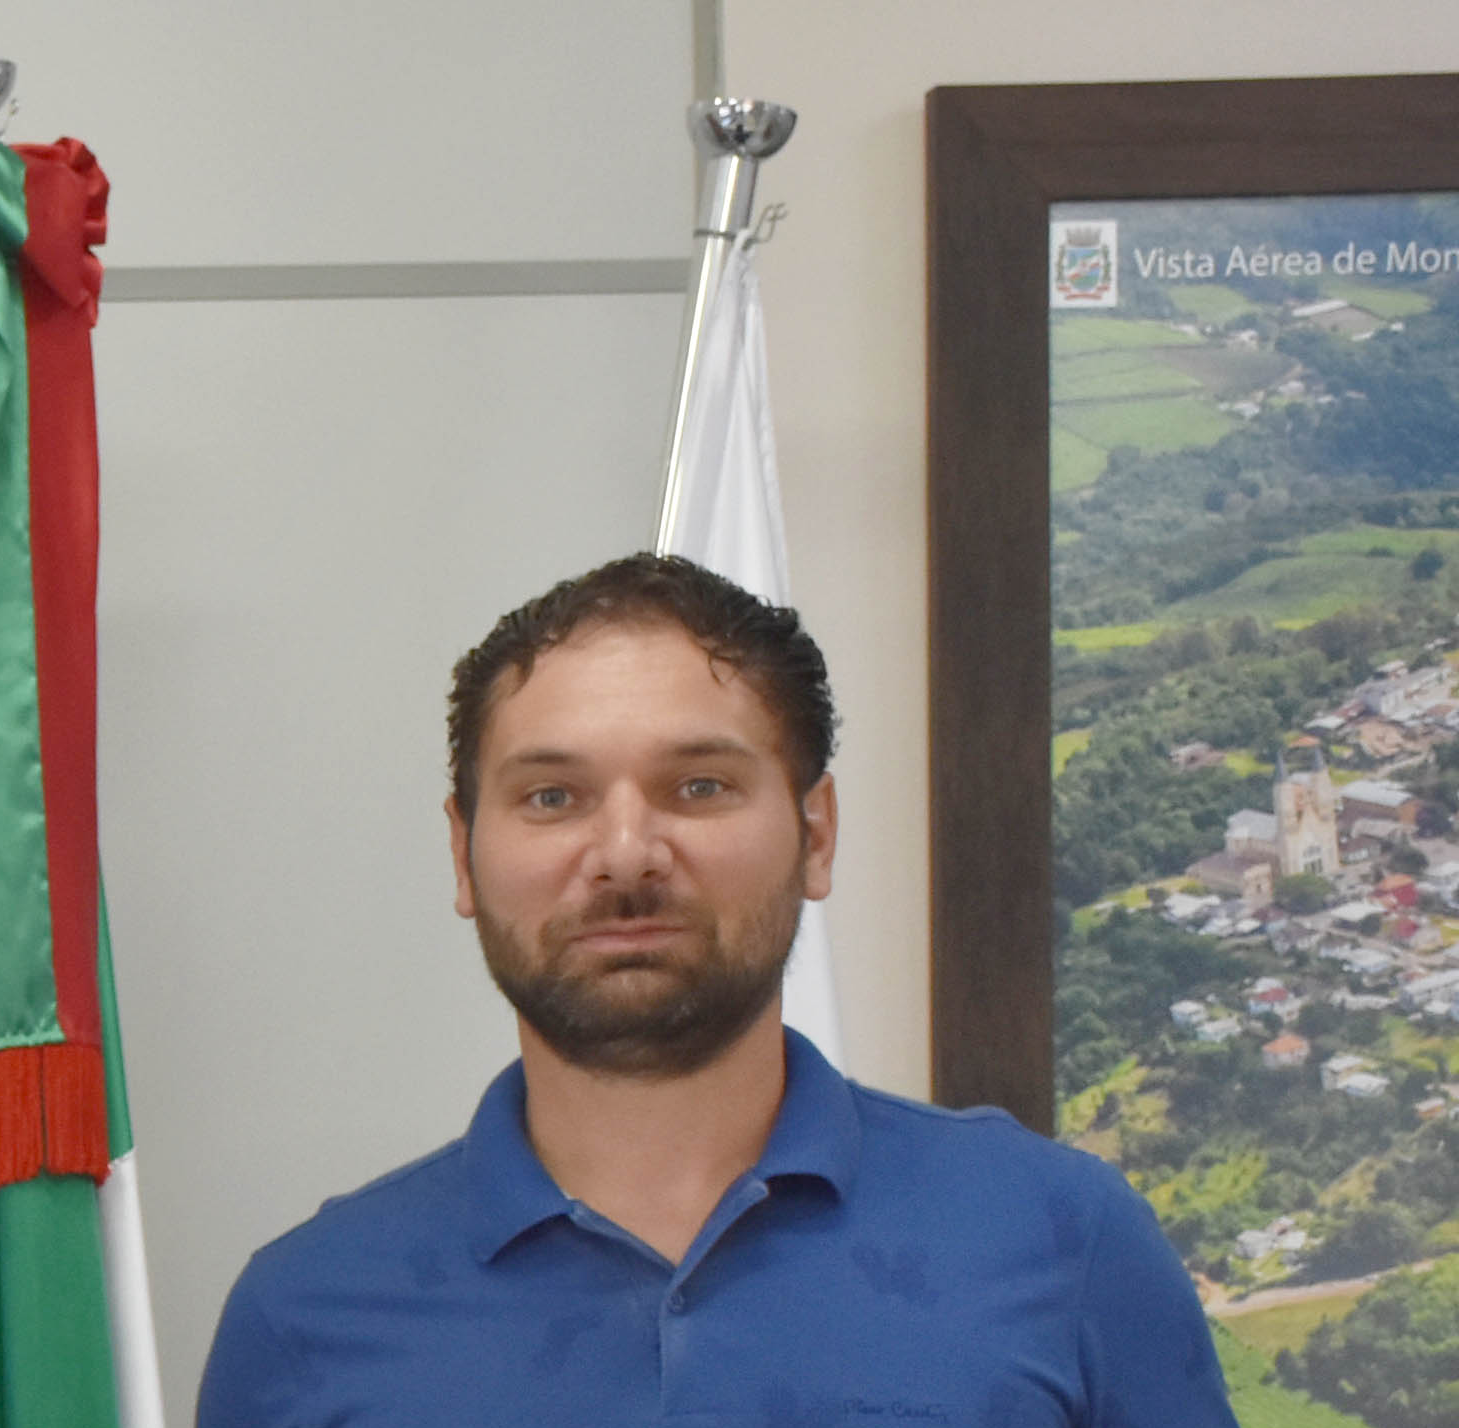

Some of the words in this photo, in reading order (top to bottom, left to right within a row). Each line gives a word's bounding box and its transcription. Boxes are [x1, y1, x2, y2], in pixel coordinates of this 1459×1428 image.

[1133, 246, 1215, 279] Vista
[1224, 243, 1323, 277] Aérea
[1333, 241, 1376, 275] de
[1386, 240, 1459, 274] Mon
